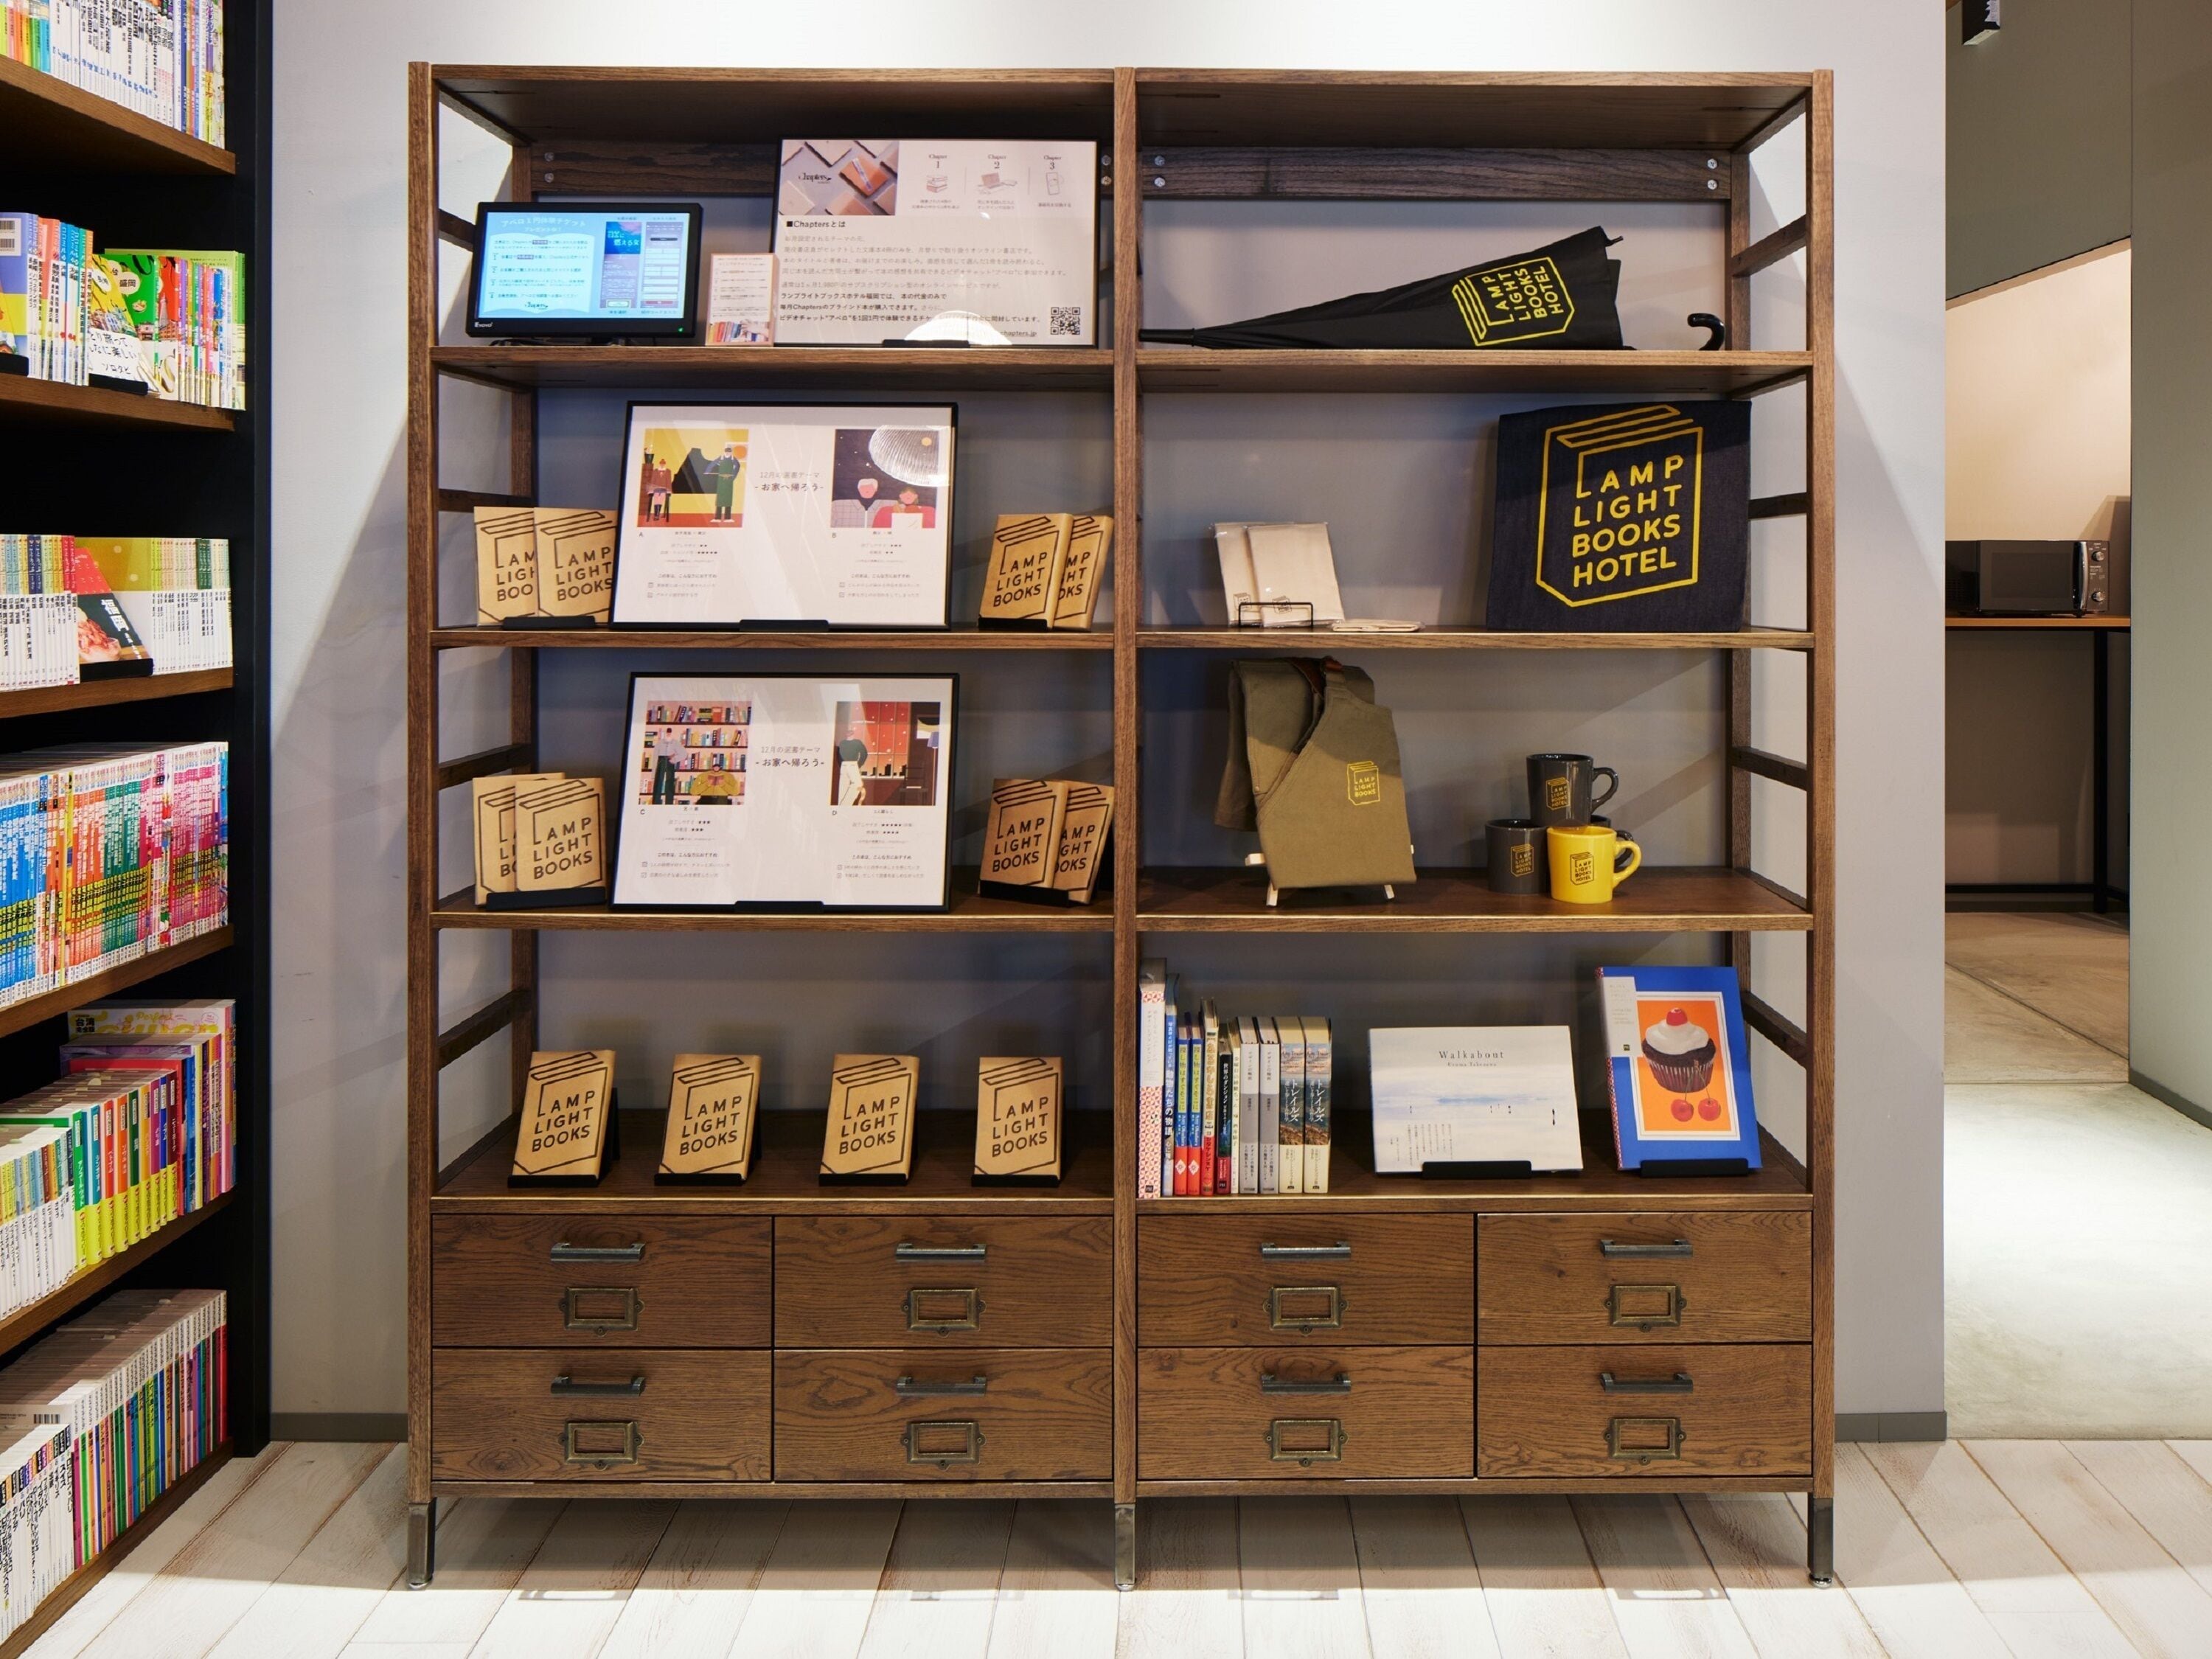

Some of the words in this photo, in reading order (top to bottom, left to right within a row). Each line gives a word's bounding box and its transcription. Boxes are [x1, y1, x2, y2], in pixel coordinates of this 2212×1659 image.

[935, 161, 940, 169] 1
[1481, 276, 1514, 326] LAMP
[1498, 273, 1531, 321] LIGHT
[1514, 268, 1548, 319] BOOKS
[1534, 265, 1564, 314] HOTEL
[1576, 453, 1684, 498] LAMP
[1573, 484, 1683, 527] LIGHT
[1572, 514, 1681, 557] BOOKS
[495, 543, 535, 568] LAM
[554, 543, 611, 568] LAMP
[1000, 549, 1047, 575] LAMP
[1066, 552, 1091, 568] MP
[1573, 546, 1677, 588] HOTEL
[496, 567, 535, 585] LIG
[556, 562, 611, 585] LIGHT
[997, 567, 1046, 591] LIGHT
[497, 584, 533, 602] BOO
[557, 578, 613, 601] BOOKS
[993, 584, 1041, 608] BOOKS
[1059, 583, 1083, 600] OKS
[1354, 775, 1377, 785] LAMP
[1354, 782, 1377, 791] LIGHT
[1354, 789, 1377, 798] BOOKS
[533, 815, 591, 845] LAMP
[998, 813, 1045, 839] LAMP
[1062, 824, 1096, 841] AMP
[534, 833, 592, 862] LIGHT
[995, 834, 1042, 855] LIGHT
[1060, 841, 1092, 857] GHT
[534, 851, 593, 880] BOOKS
[992, 851, 1040, 872] BOOKS
[1439, 1049, 1505, 1060] Walkabout
[538, 1088, 596, 1117] LAMP
[684, 1093, 742, 1120] LAMP
[844, 1093, 900, 1120] LAMP
[993, 1094, 1048, 1121] LAMP
[1288, 1079, 1300, 1122] トレイルズ
[1313, 1079, 1326, 1122] トレイルズ
[534, 1107, 594, 1135] LIGHT
[681, 1112, 741, 1138] LIGHT
[841, 1112, 898, 1138] LIGHT
[992, 1113, 1048, 1140] LIGHT
[531, 1125, 590, 1152] BOOKS
[679, 1130, 738, 1156] BOOKS
[839, 1130, 896, 1155] BOOKS
[992, 1131, 1048, 1158] BOOKS
